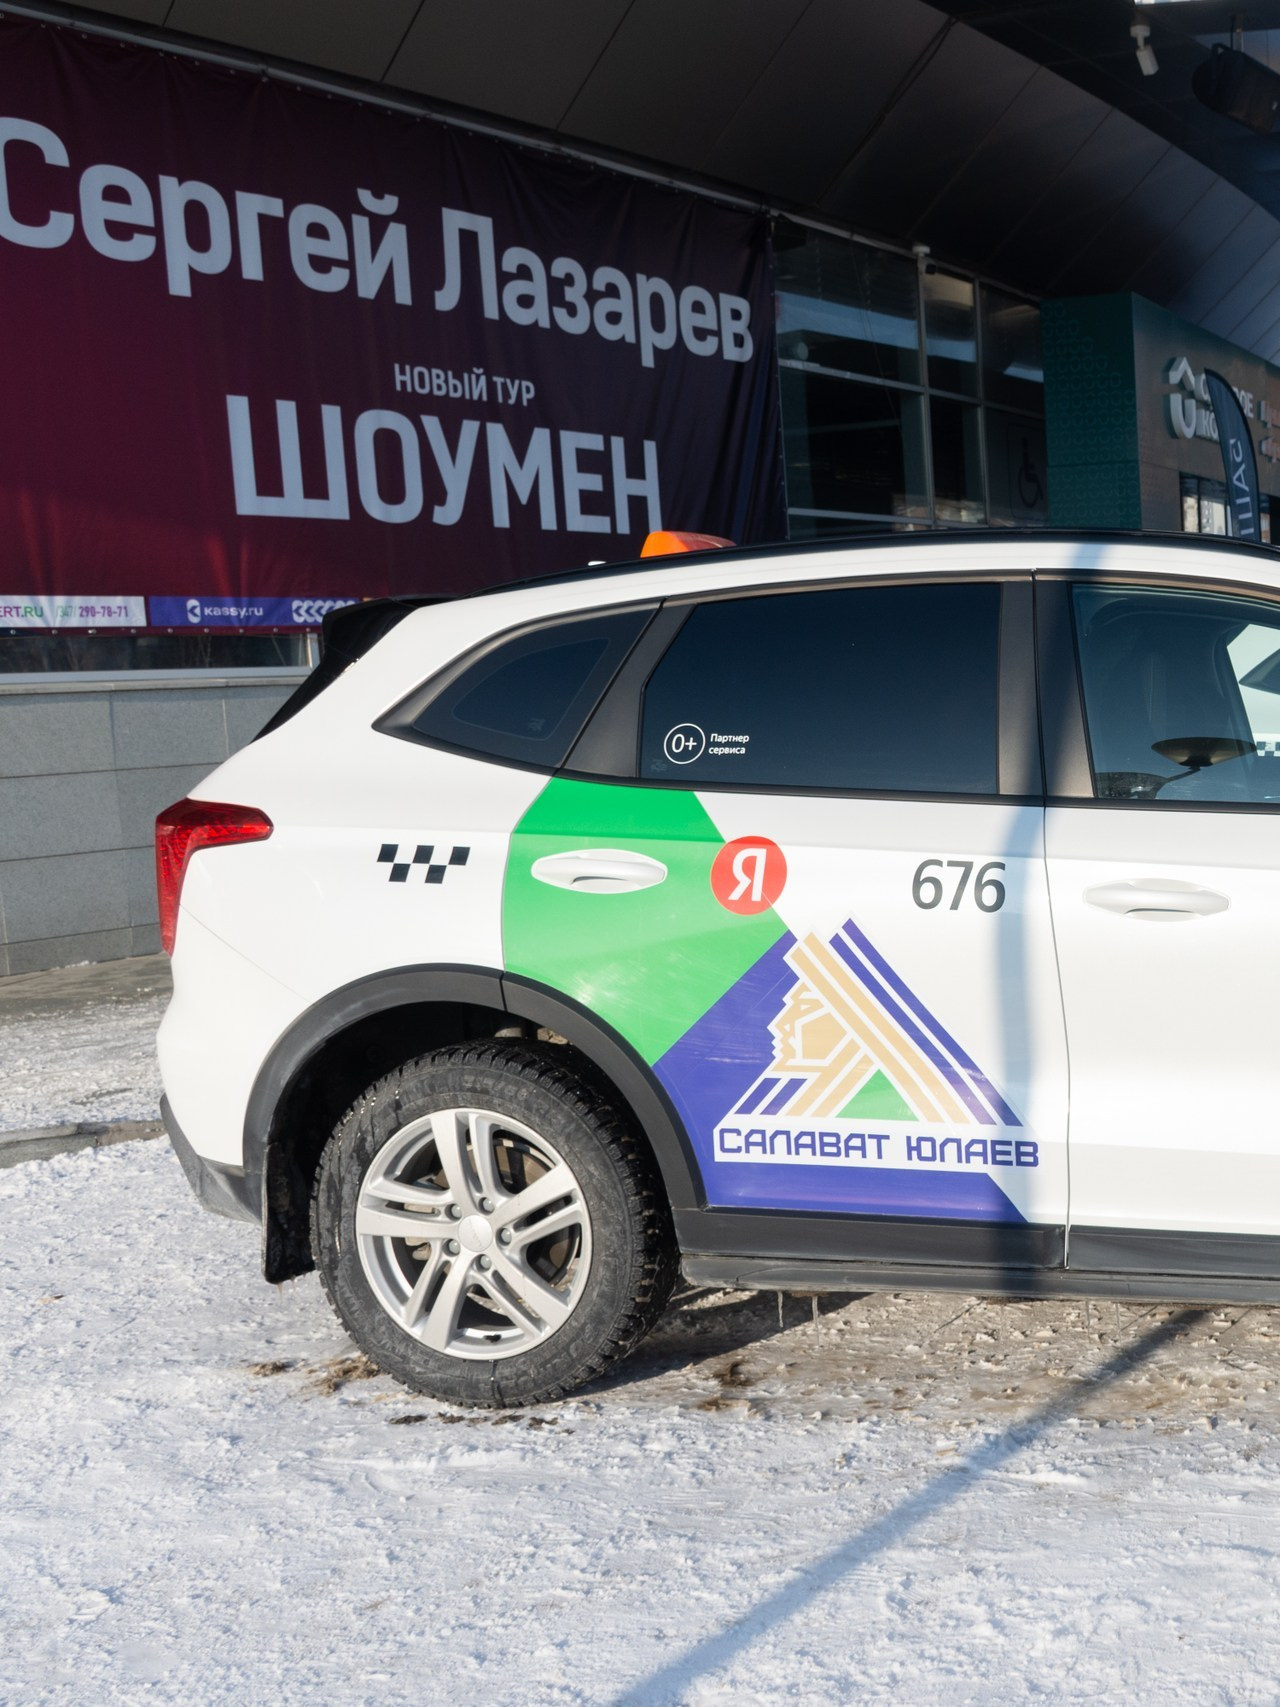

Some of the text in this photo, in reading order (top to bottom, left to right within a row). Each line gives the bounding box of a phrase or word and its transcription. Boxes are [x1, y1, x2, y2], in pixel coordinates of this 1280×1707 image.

[0, 116, 754, 368] Сергей Лазарев
[394, 363, 536, 407] НОВЫЙ ТУР
[226, 395, 661, 535] ШОУМЕН
[79, 605, 129, 618] 290-78-71
[671, 733, 698, 753] 0+
[708, 747, 746, 756] сервиса
[710, 733, 750, 744] Партнер
[728, 848, 768, 902] Я
[912, 859, 1006, 912] 676
[719, 1127, 1039, 1168] САЛАВАТ ЮЛАЕВ
